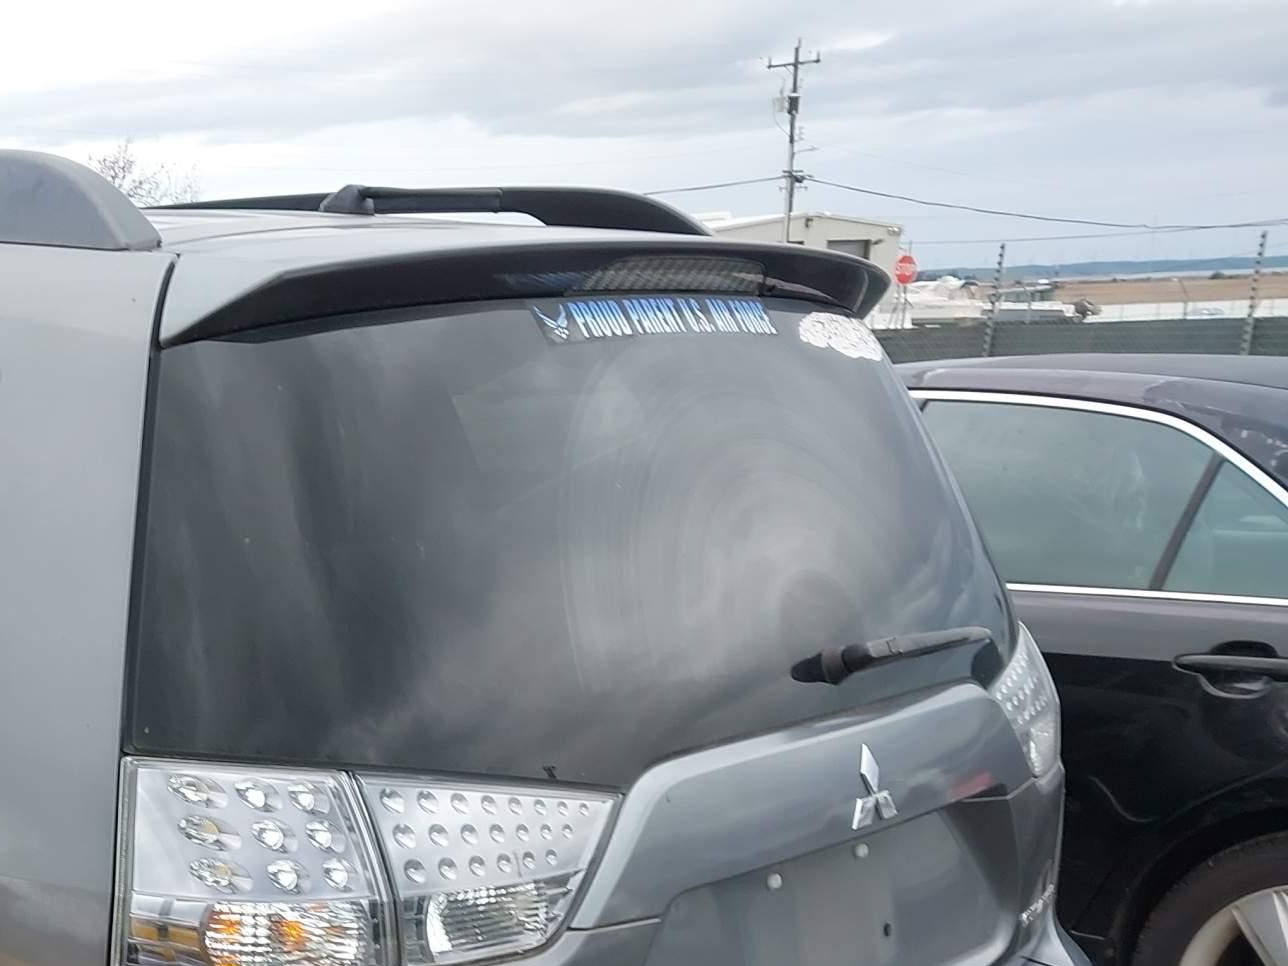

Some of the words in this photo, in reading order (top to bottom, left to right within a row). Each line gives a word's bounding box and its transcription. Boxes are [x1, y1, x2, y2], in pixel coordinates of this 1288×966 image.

[567, 299, 633, 338] PROUD
[622, 298, 688, 335] PARENT
[676, 298, 717, 334] U.S.
[704, 298, 740, 333] AIR
[727, 299, 779, 335] FORCE
